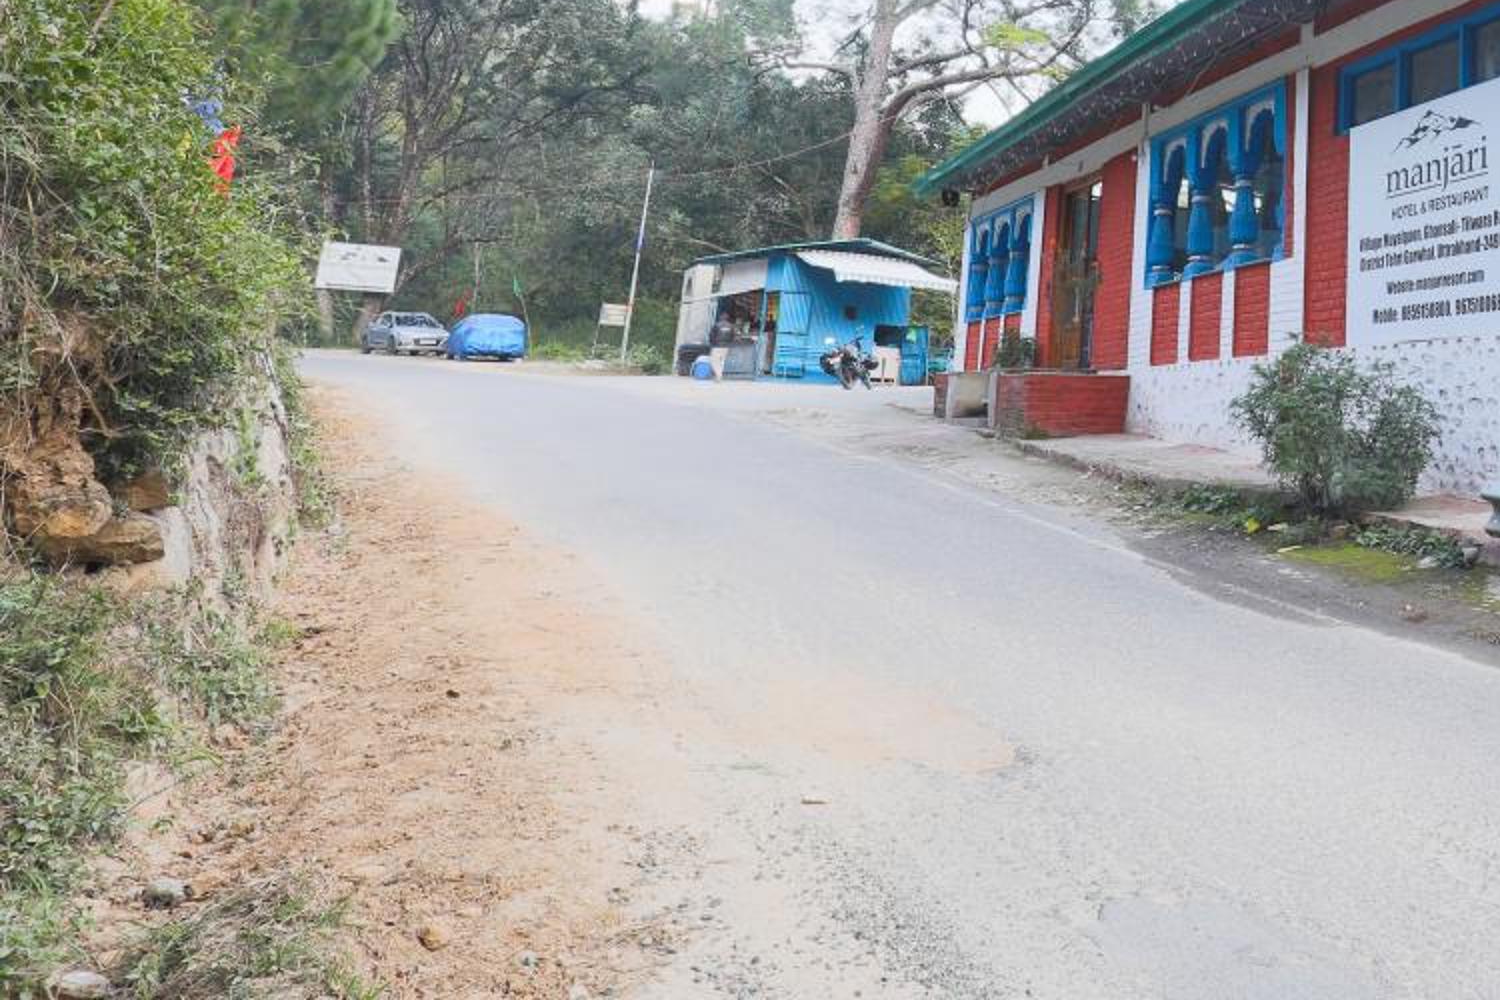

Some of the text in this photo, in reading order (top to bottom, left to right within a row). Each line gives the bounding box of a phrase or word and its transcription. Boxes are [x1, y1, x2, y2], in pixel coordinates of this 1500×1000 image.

[1391, 185, 1489, 220] HOTEL & RESTAURANT
